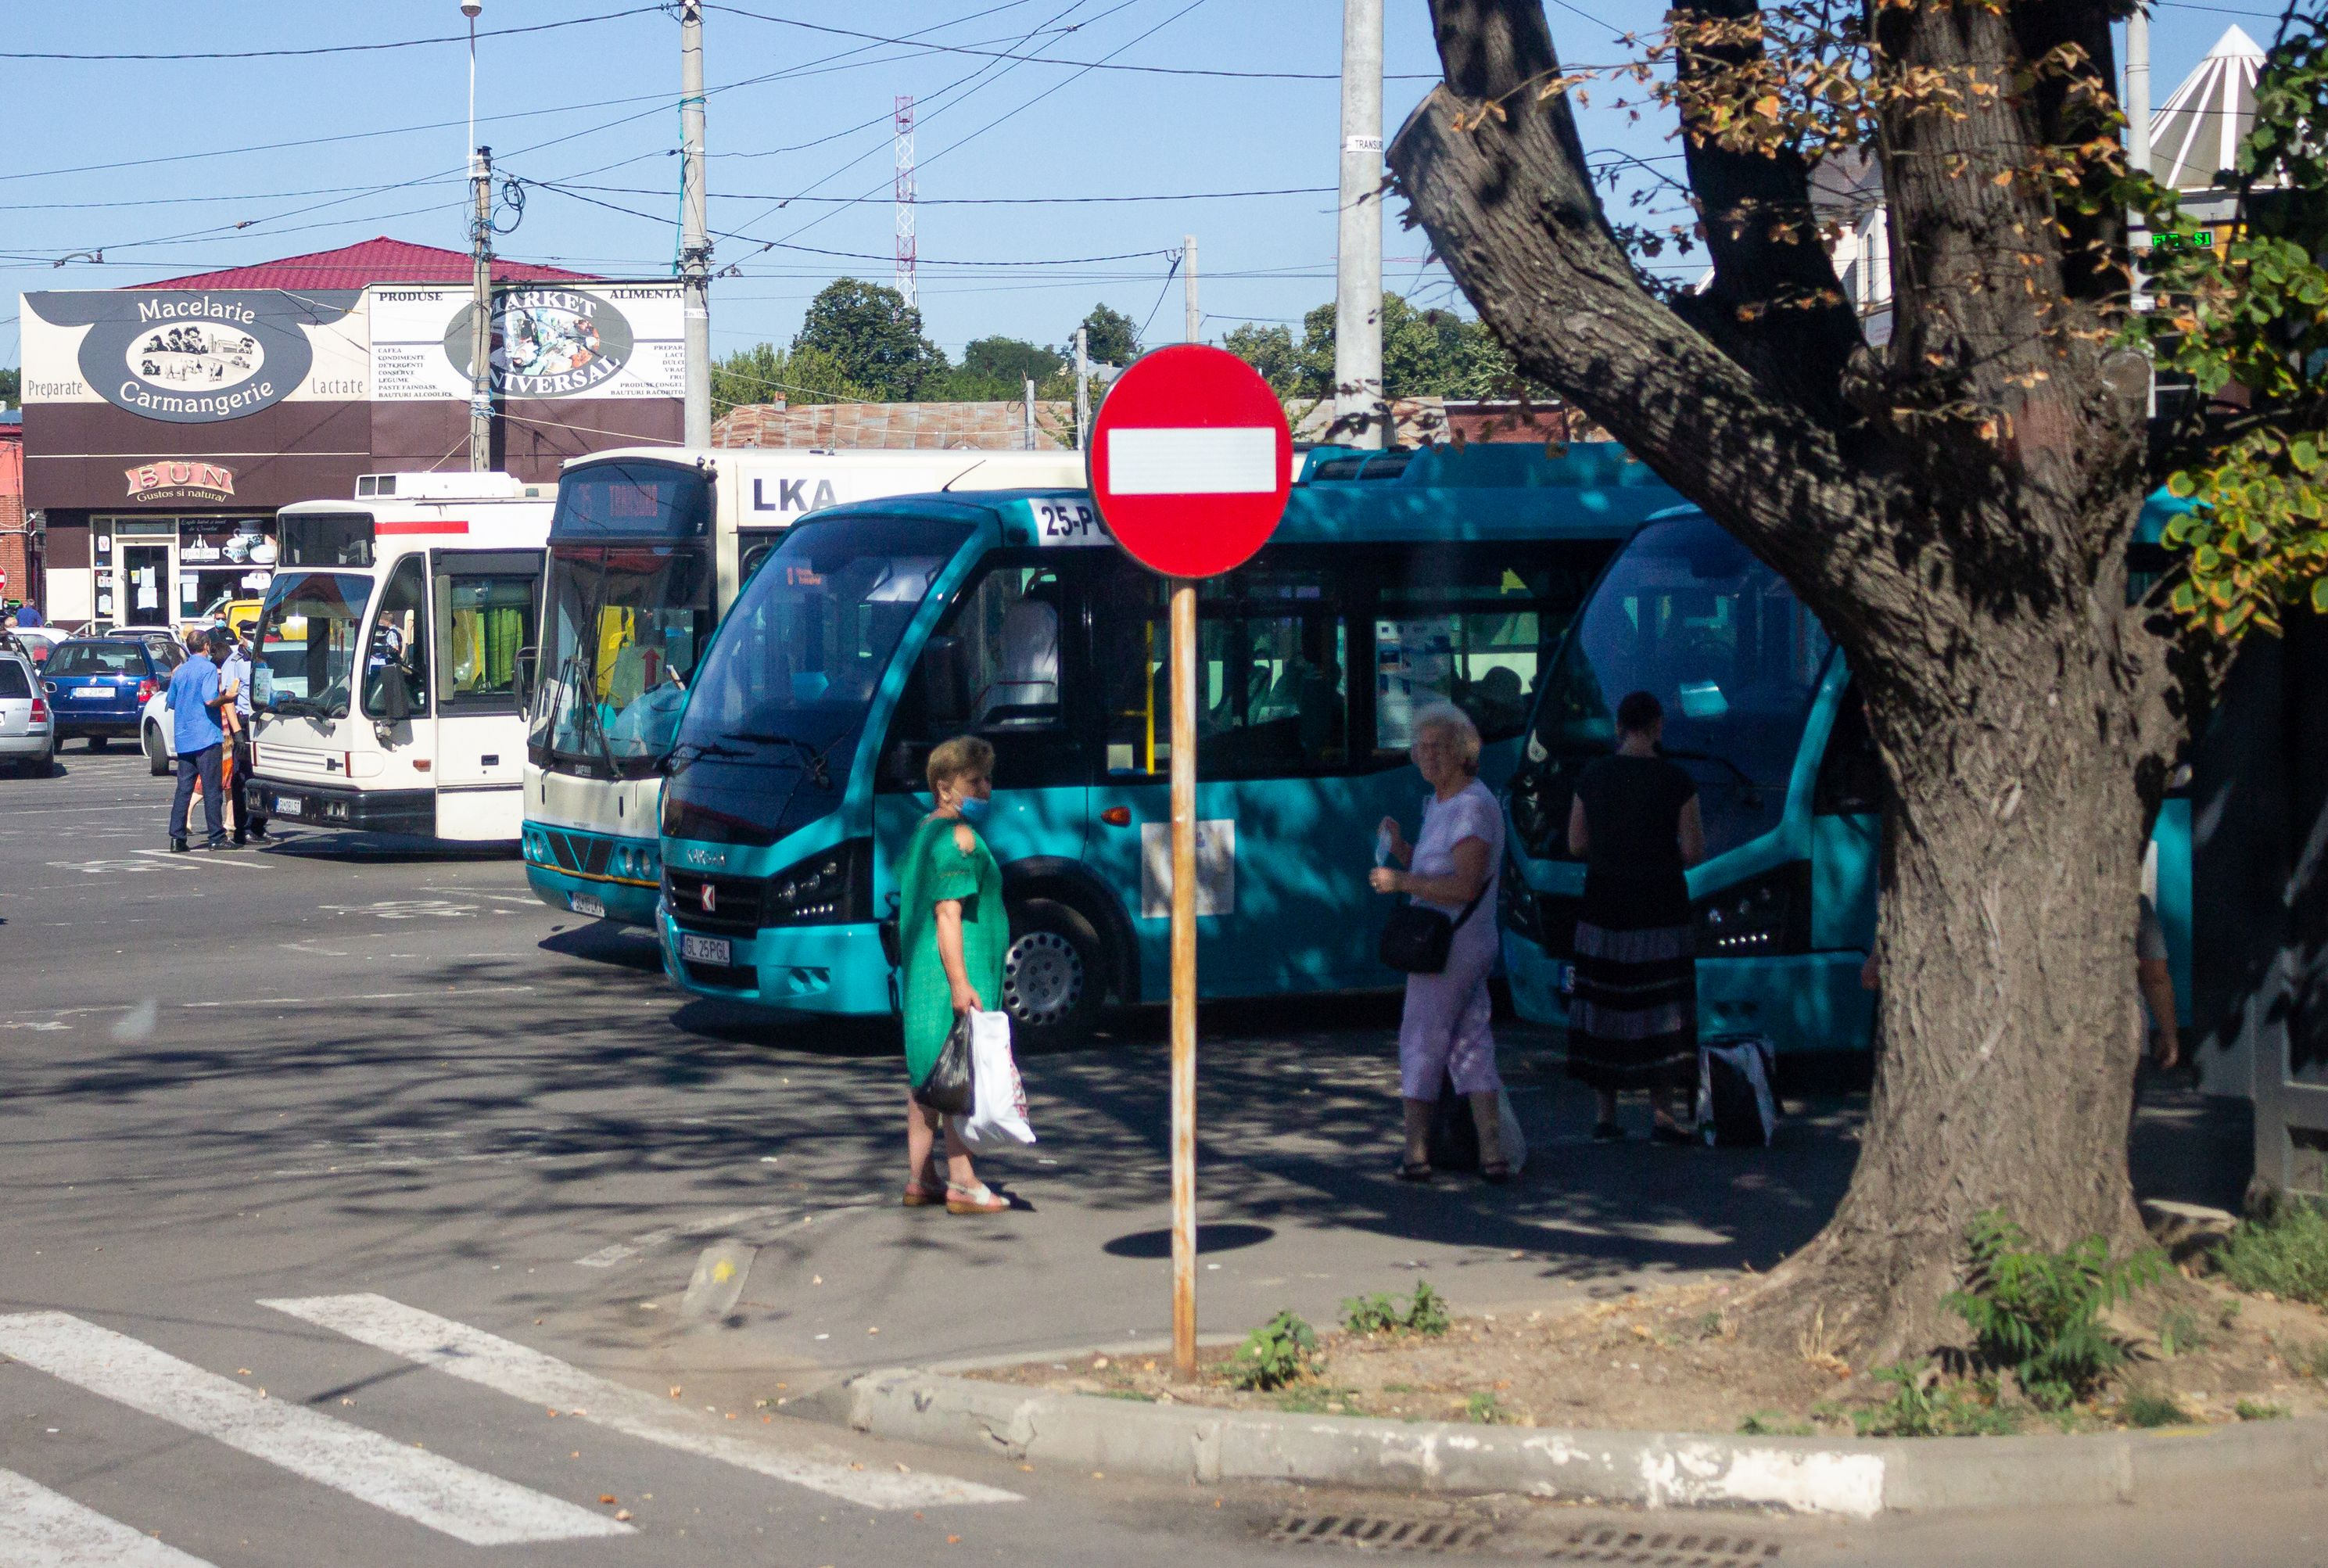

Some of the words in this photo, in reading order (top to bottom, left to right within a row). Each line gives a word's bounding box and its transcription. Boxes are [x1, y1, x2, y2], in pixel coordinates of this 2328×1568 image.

[378, 292, 443, 302] PRODUSE
[610, 289, 683, 299] ALIMENTA
[138, 296, 256, 325] Macelarie
[28, 380, 83, 398] Preparate
[313, 378, 363, 393] Lactate
[120, 382, 274, 416] Carmangerie
[139, 465, 227, 488] BUN
[137, 490, 174, 502] Gustos
[176, 488, 185, 497] si
[188, 490, 227, 503] natural
[754, 479, 837, 511] LKA
